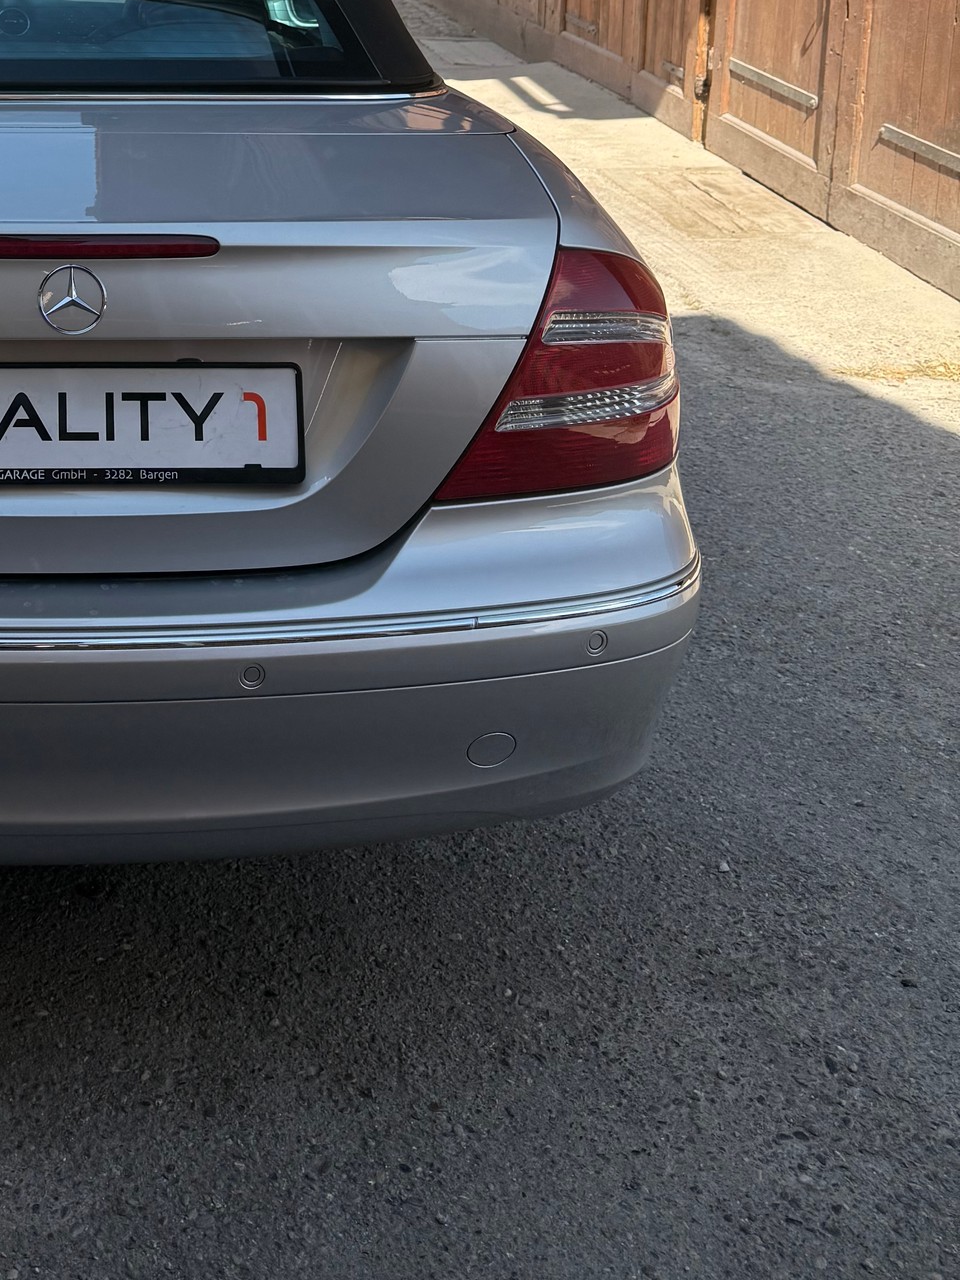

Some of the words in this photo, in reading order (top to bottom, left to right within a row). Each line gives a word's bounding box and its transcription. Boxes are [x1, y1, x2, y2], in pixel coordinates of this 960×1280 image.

[51, 469, 87, 480] GmbH
[104, 469, 133, 480] 3282
[140, 469, 179, 482] Bargen
